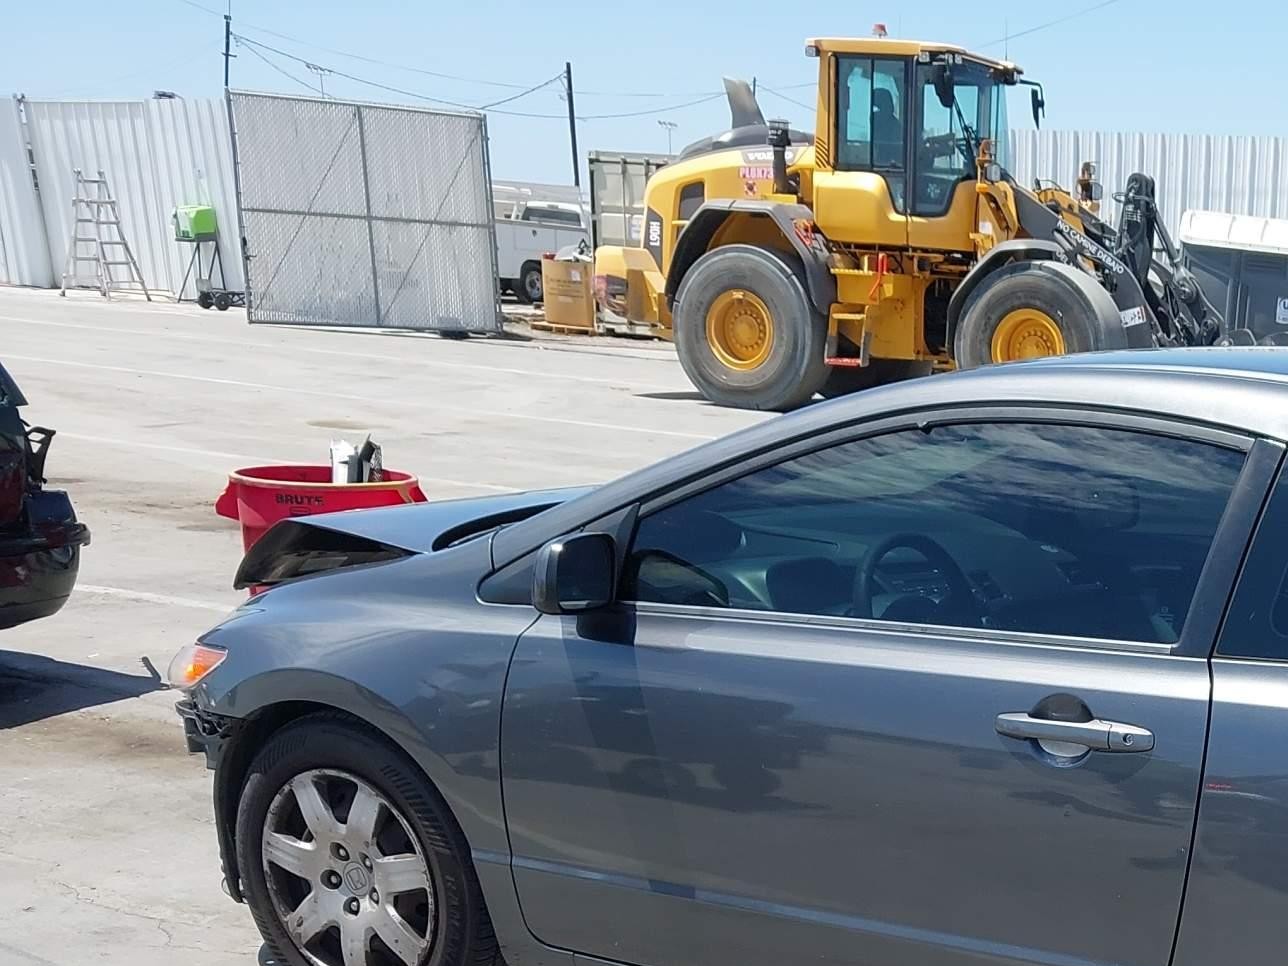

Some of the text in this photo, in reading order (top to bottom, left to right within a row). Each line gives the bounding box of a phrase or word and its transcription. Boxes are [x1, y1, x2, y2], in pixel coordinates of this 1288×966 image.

[747, 152, 793, 160] VOLO
[1057, 220, 1069, 232] NO
[649, 221, 660, 246] L90H
[275, 493, 324, 506] BRUTE
